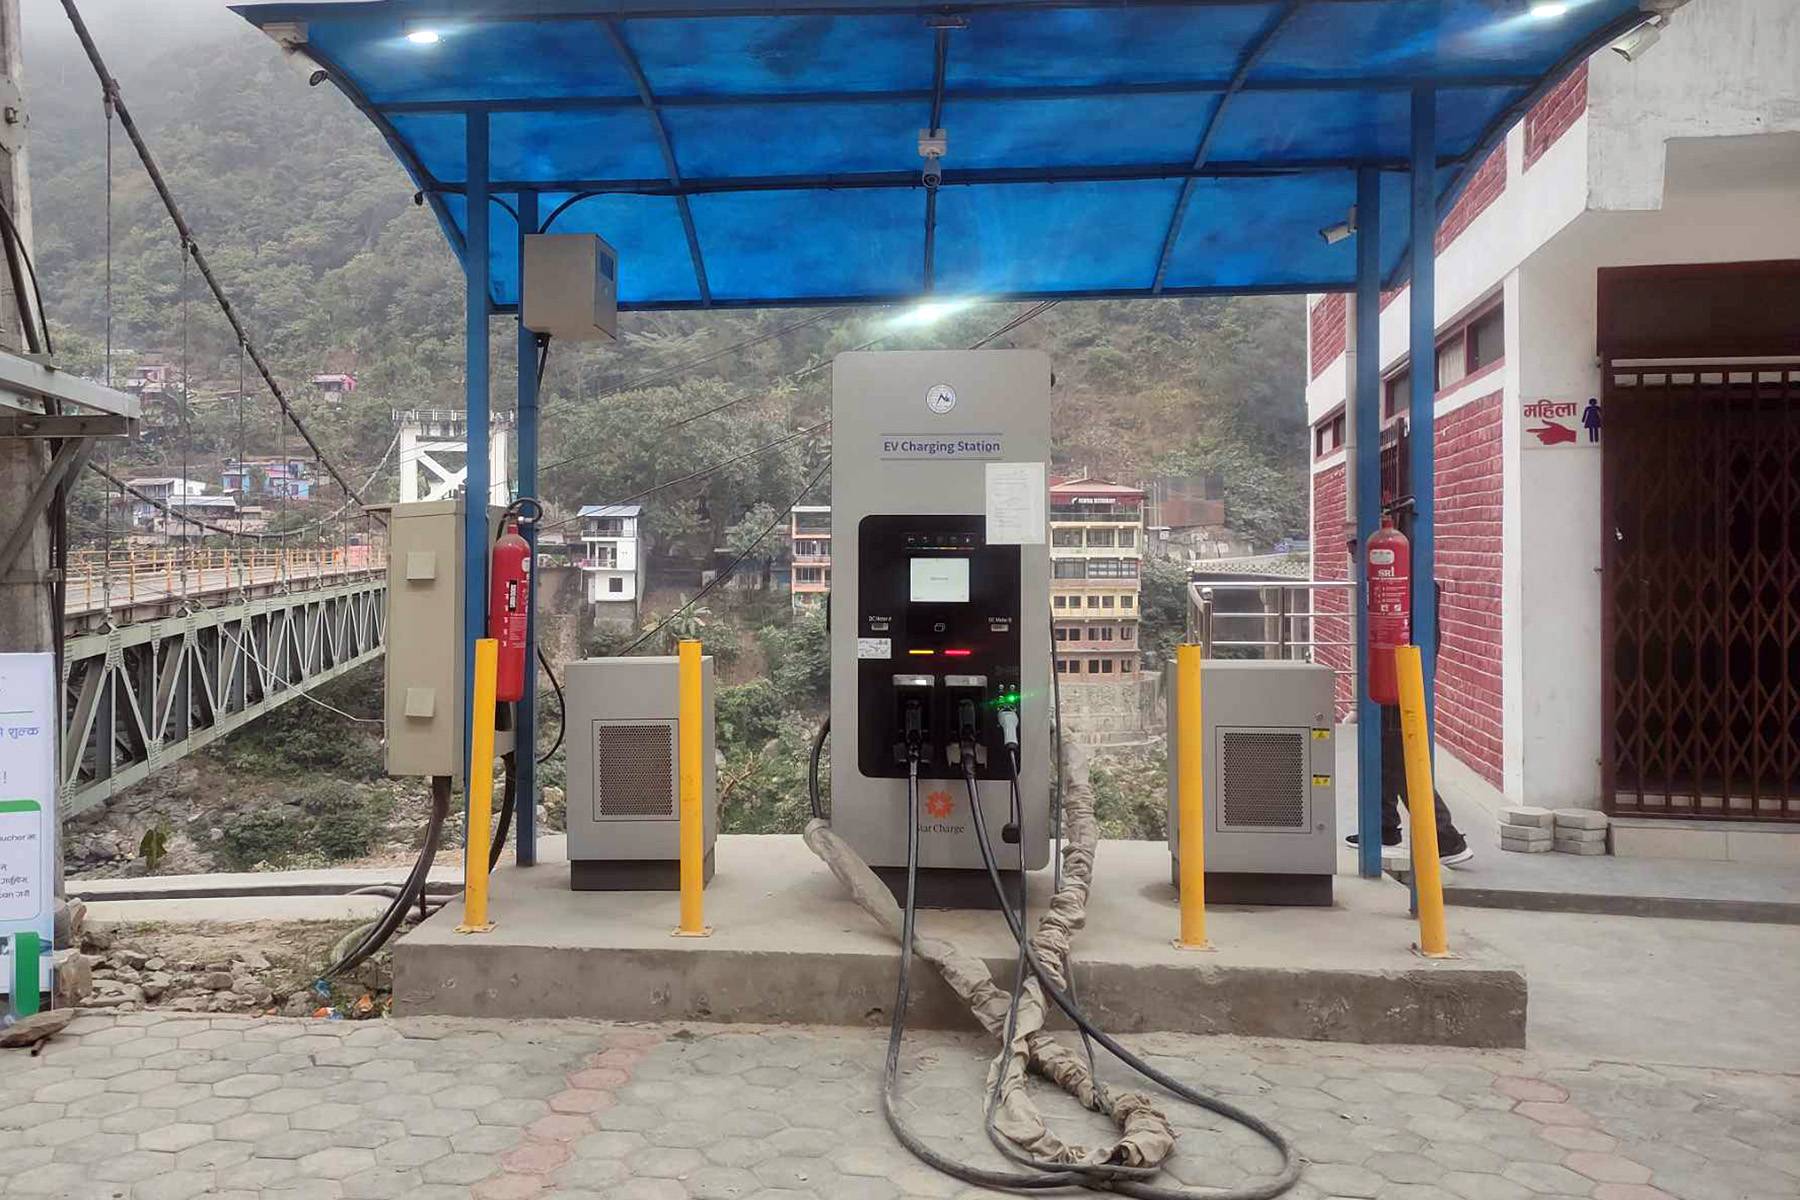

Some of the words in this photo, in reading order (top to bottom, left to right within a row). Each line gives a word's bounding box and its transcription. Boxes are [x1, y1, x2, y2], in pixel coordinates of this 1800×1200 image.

[1523, 399, 1578, 419] महिला
[884, 441, 898, 451] EV
[901, 441, 955, 454] Charging
[957, 441, 1001, 452] Station
[8, 727, 40, 740] शुल्क
[933, 823, 965, 834] Charge
